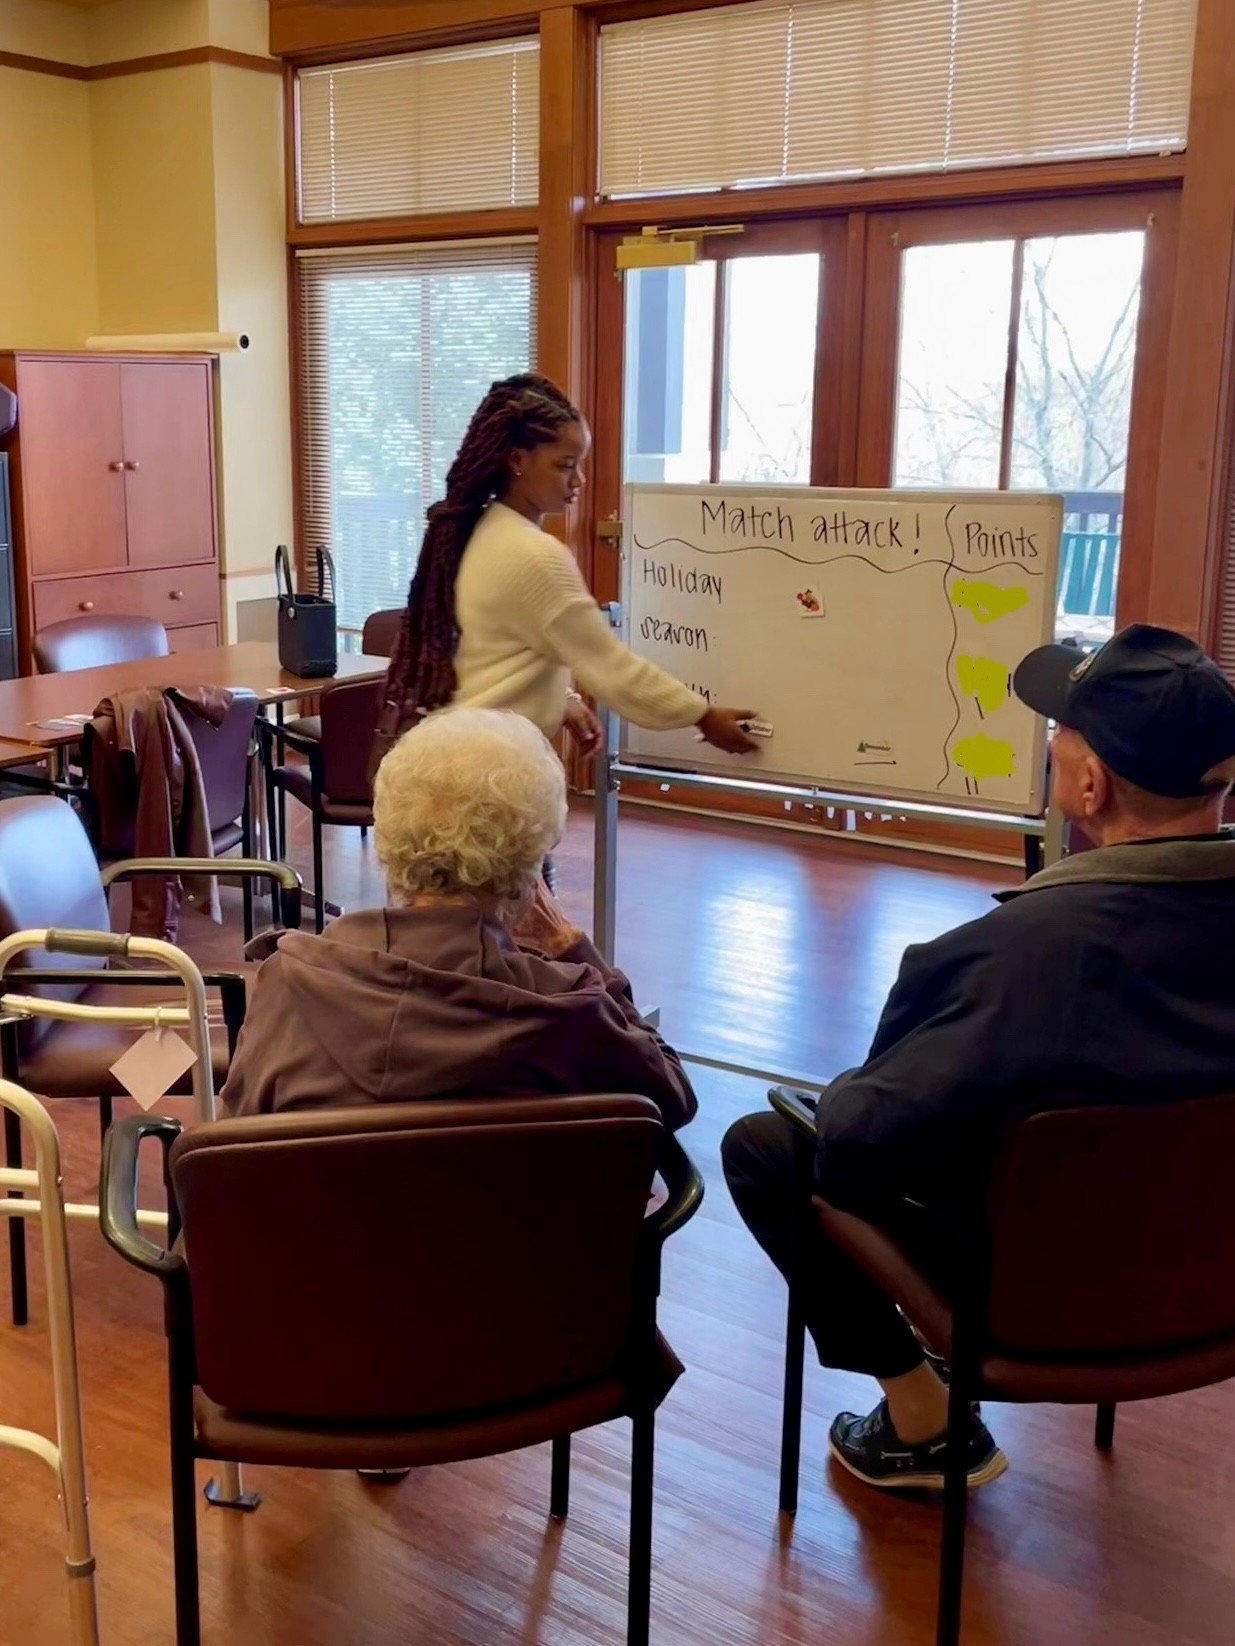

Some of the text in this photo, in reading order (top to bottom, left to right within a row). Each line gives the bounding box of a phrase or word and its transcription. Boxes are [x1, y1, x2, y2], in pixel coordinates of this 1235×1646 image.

[701, 499, 794, 542] Match
[965, 521, 1038, 558] Points
[643, 558, 722, 604] Holiday
